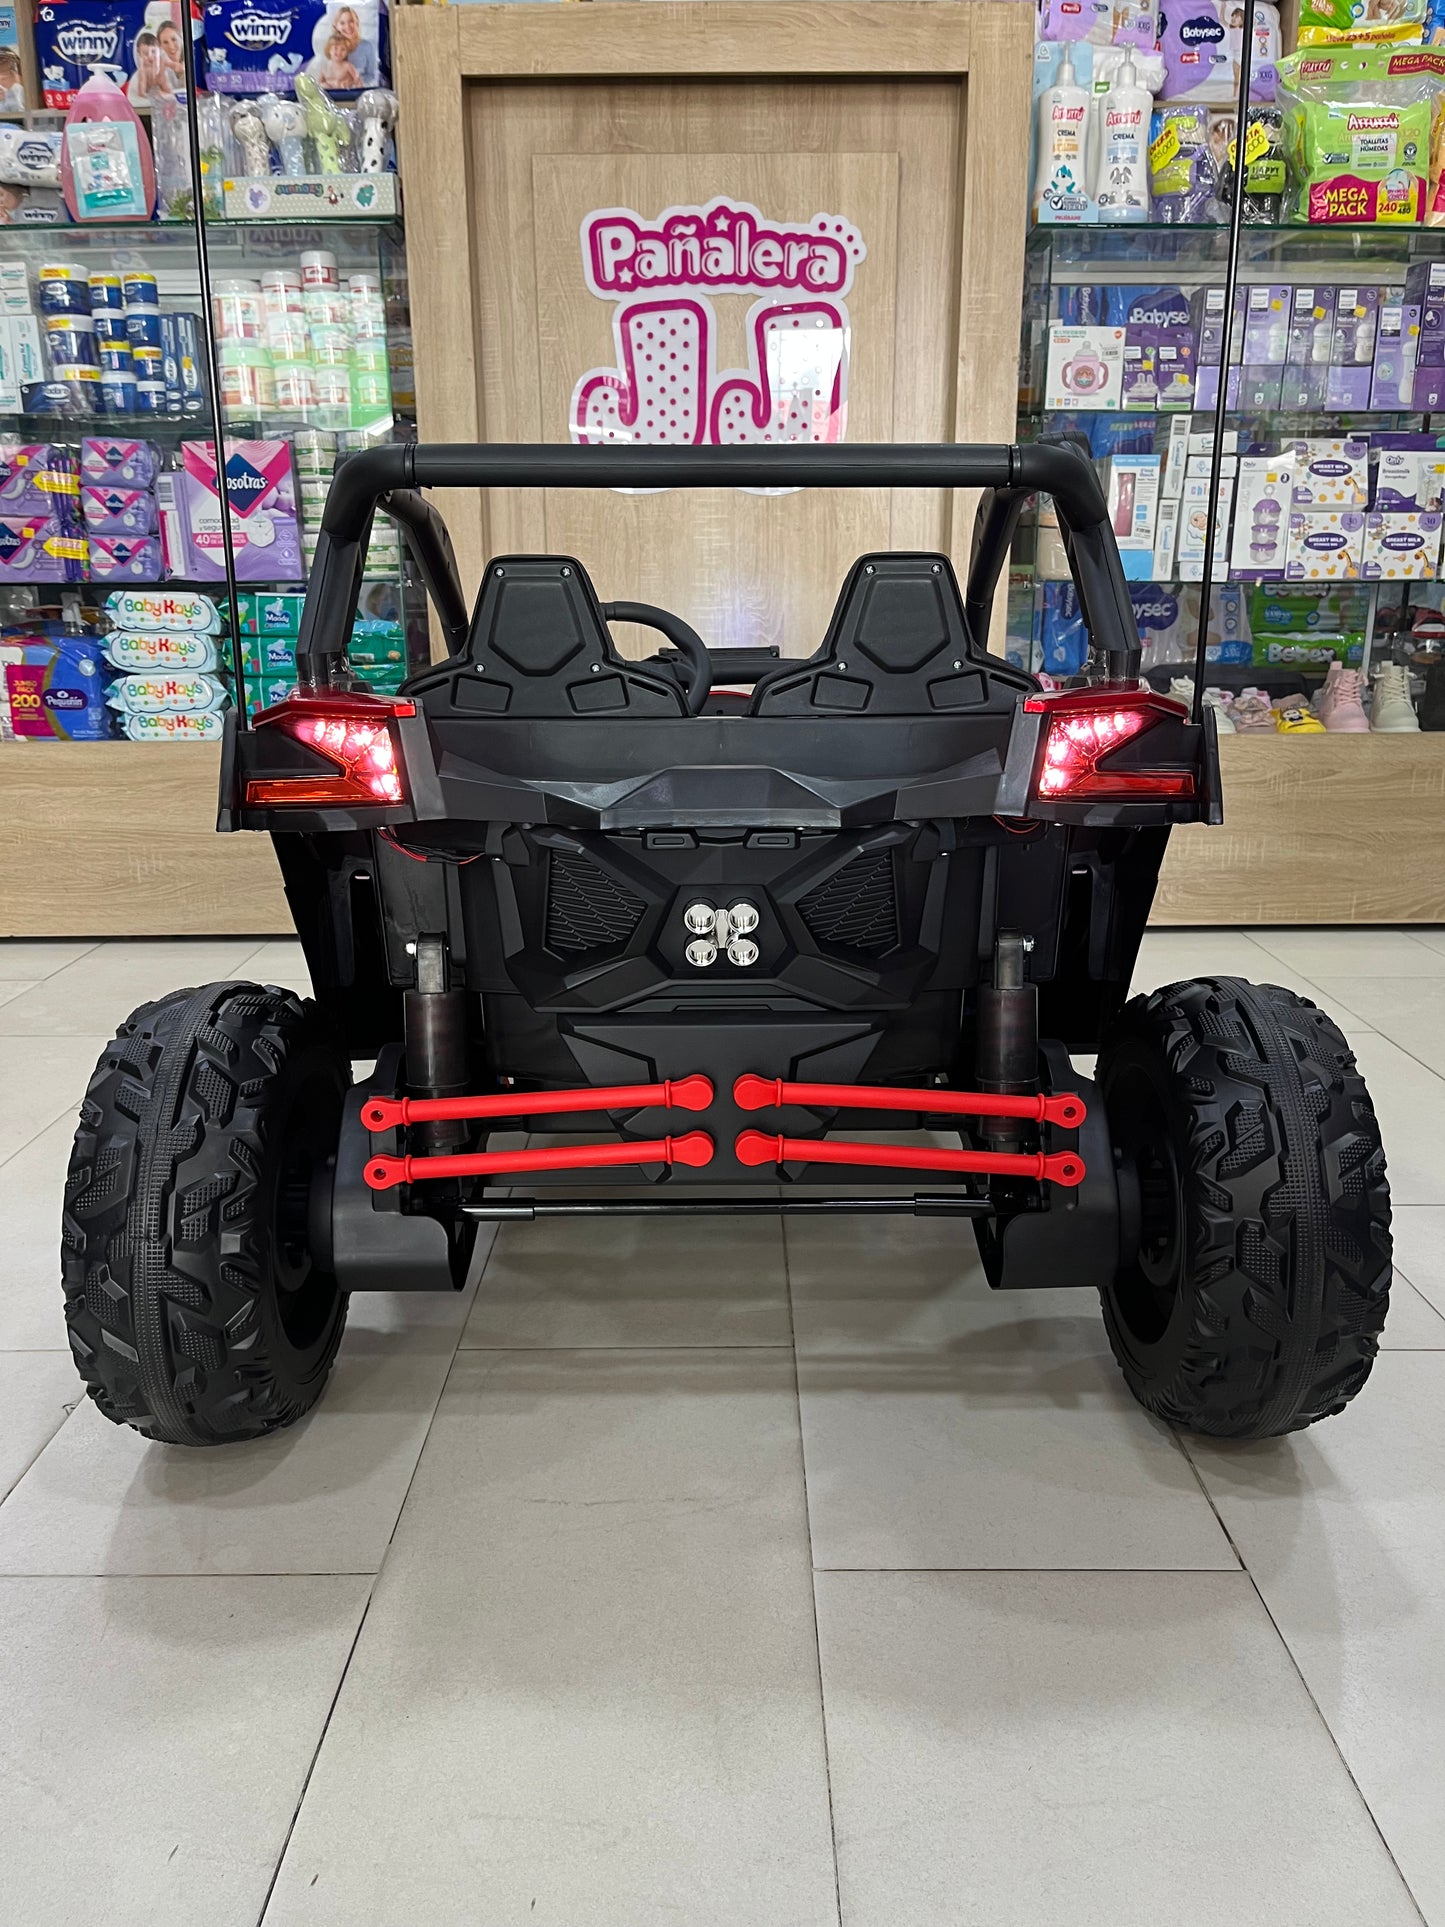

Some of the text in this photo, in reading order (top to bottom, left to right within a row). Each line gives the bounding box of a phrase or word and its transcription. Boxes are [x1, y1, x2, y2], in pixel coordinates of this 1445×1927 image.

[234, 18, 288, 41] winny
[1183, 27, 1221, 38] Babysec
[62, 30, 114, 55] winny
[1393, 55, 1445, 67] MEGA PACK
[1113, 133, 1135, 141] CREMA
[1325, 188, 1368, 202] MEGA
[1329, 202, 1367, 217] PACK
[1379, 203, 1397, 213] 240
[597, 220, 840, 285] Pañalera
[1132, 308, 1189, 328] Babyse
[195, 534, 210, 544] 40
[124, 598, 202, 618] Baby Kay's
[1132, 602, 1172, 620] ysec
[266, 613, 290, 623] Moody
[120, 637, 196, 656] Baby Kay's
[268, 653, 292, 662] Moody
[127, 680, 203, 699] Baby Kay's
[11, 694, 41, 708] 200
[138, 715, 214, 731] Baby Kay's
